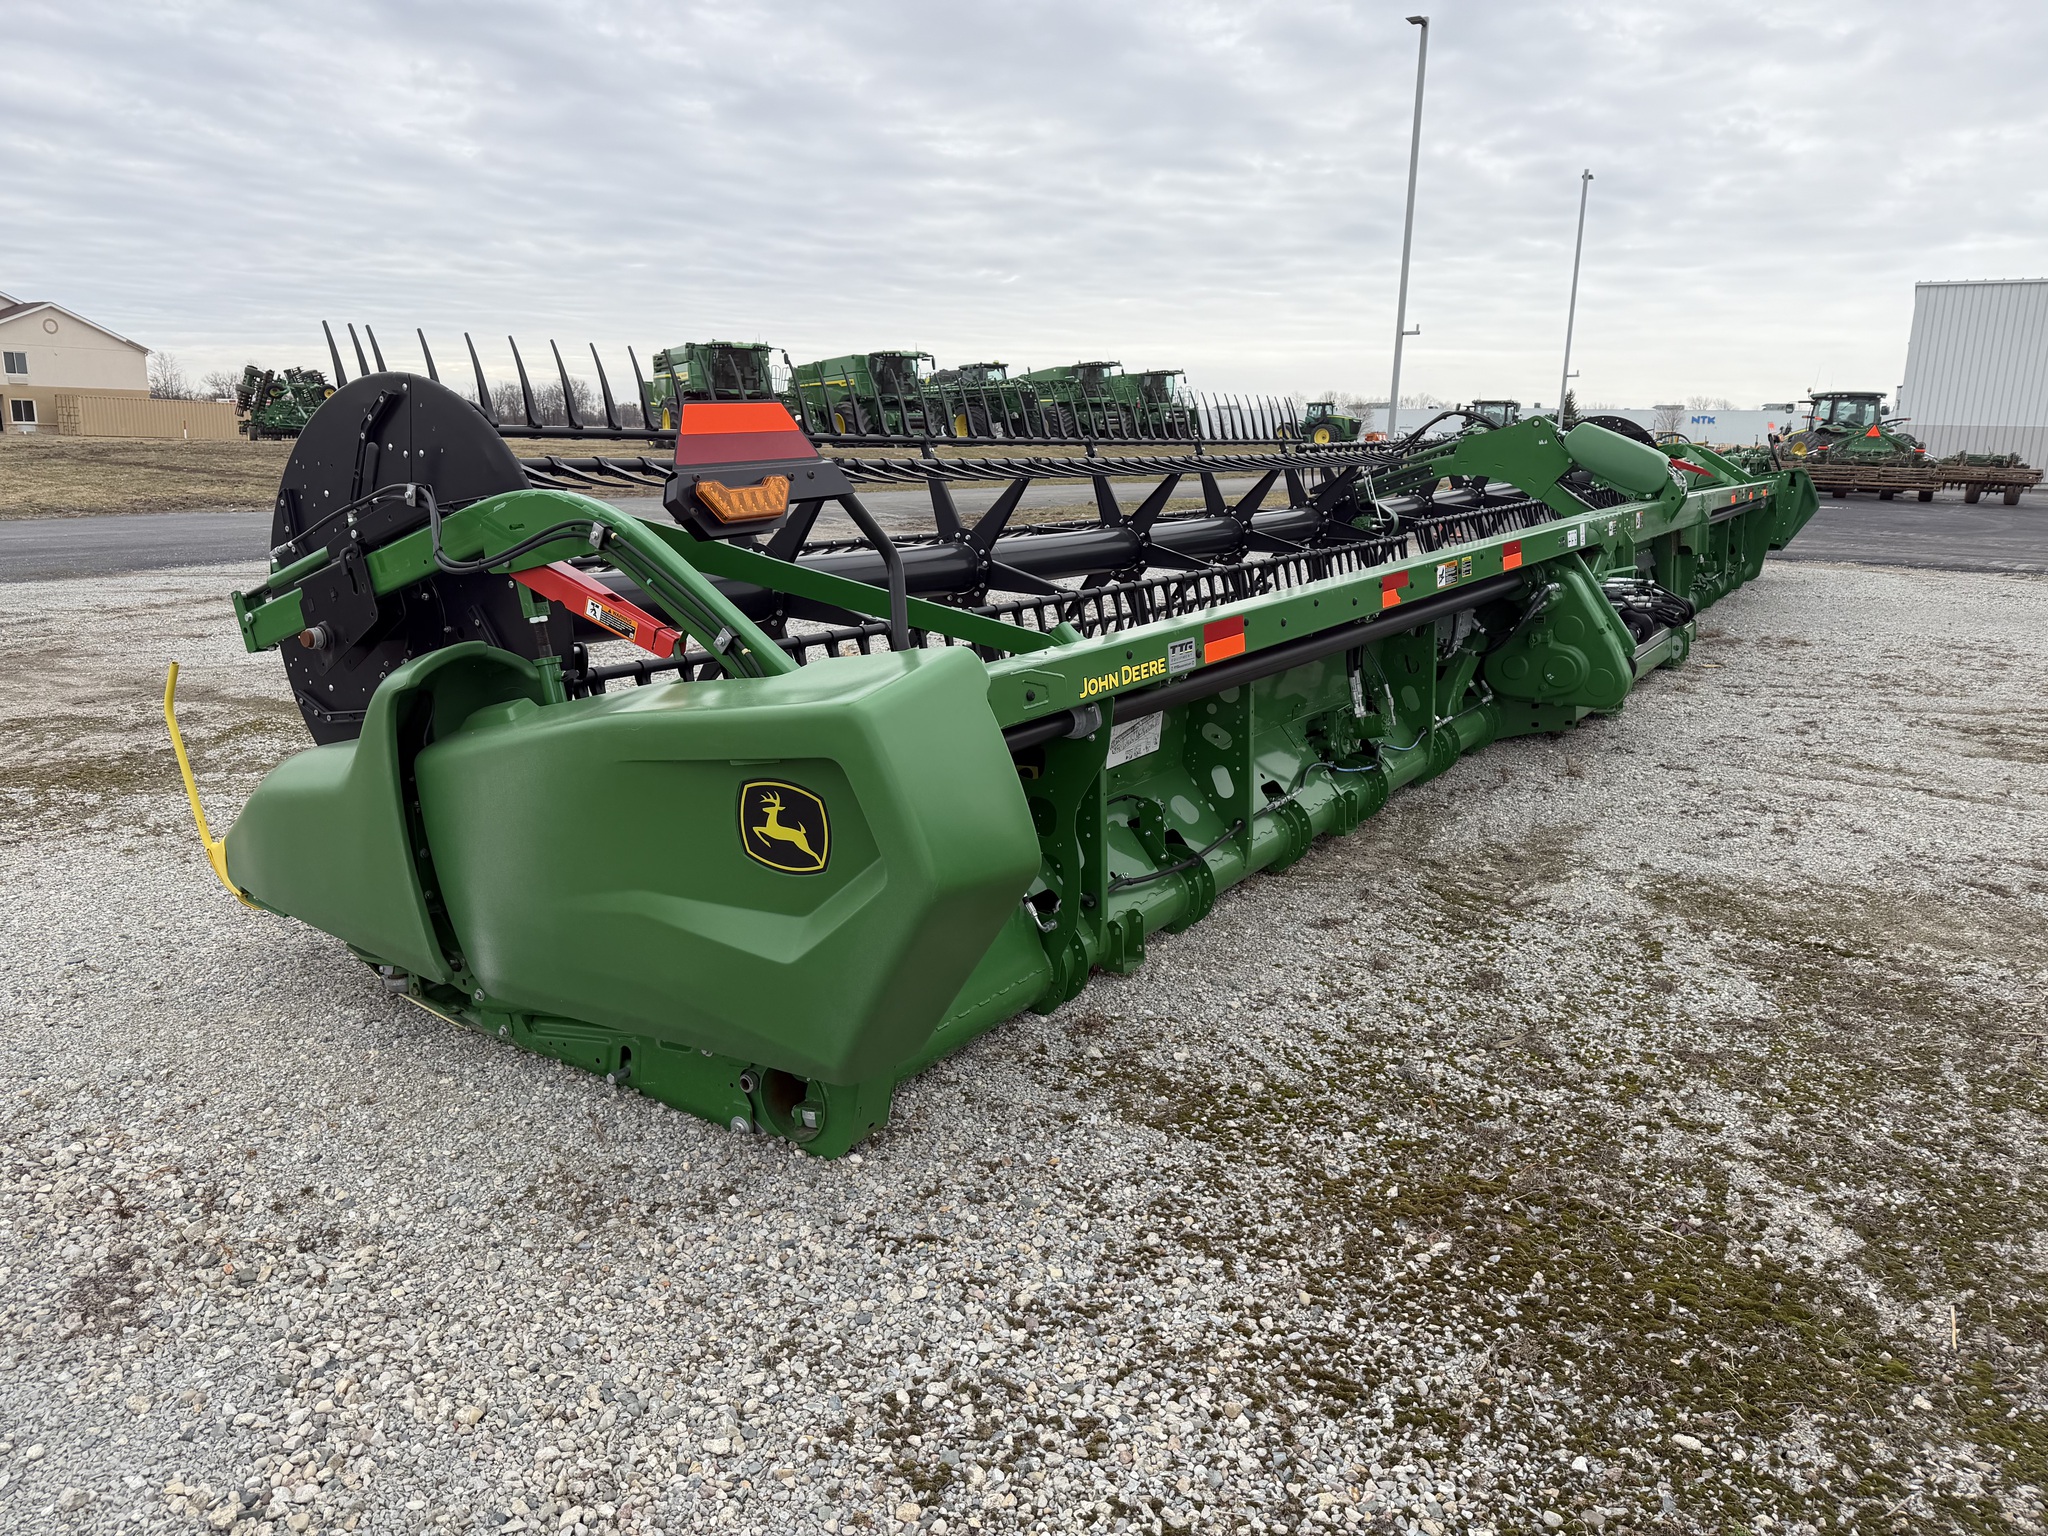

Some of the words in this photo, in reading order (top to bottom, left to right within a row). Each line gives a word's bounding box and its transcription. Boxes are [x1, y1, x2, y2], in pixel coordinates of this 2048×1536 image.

[1691, 416, 1716, 424] NTK
[612, 610, 632, 625] WARNING
[1170, 641, 1193, 656] TTG
[1079, 671, 1120, 699] JOHN
[1121, 657, 1167, 687] DEERE
